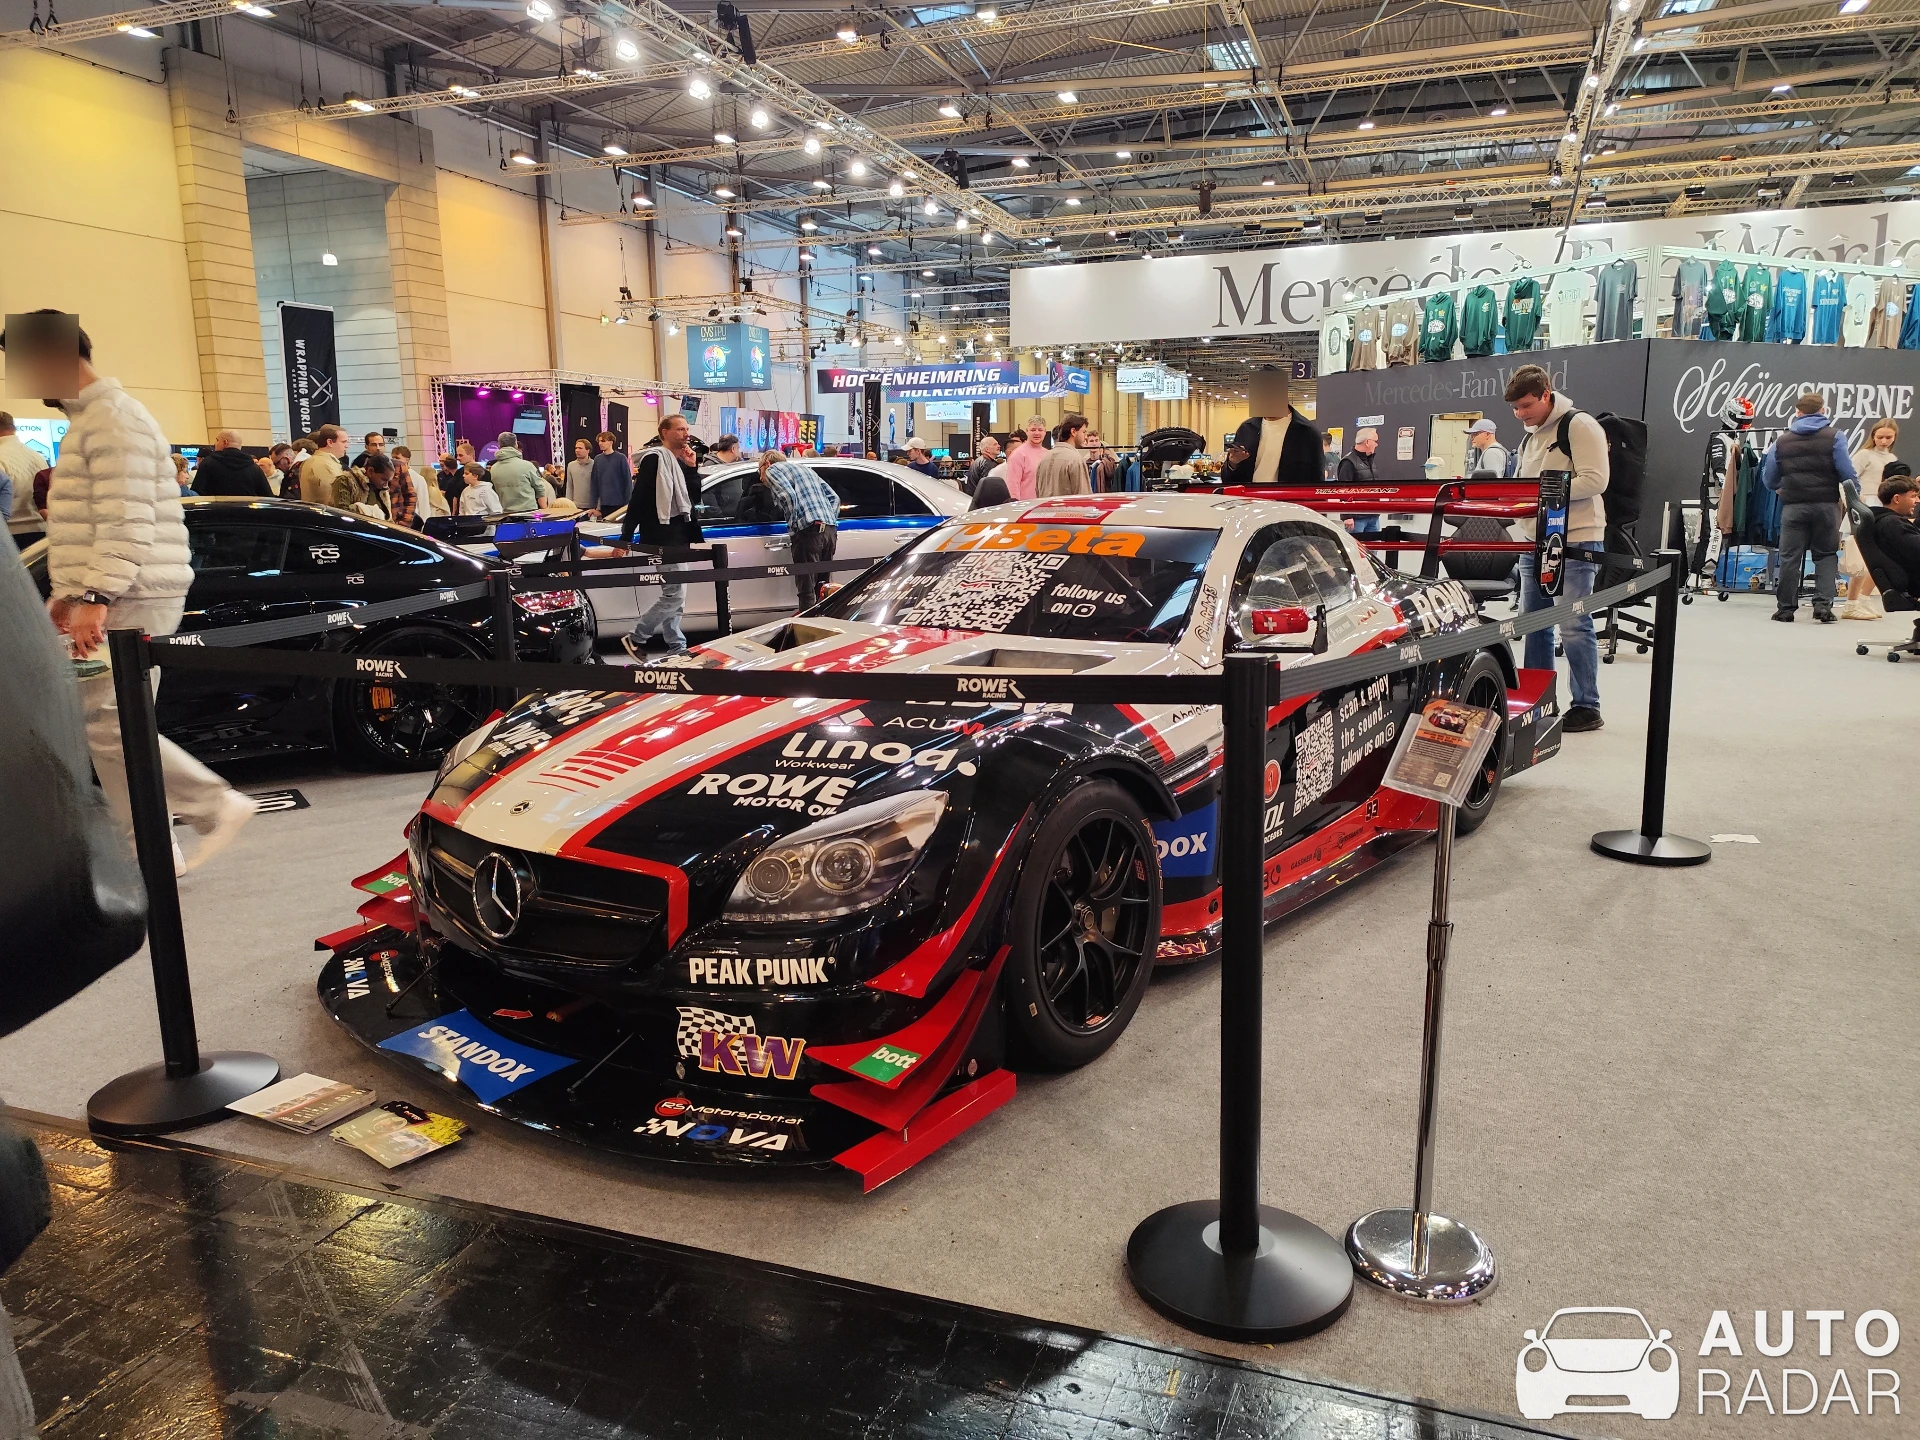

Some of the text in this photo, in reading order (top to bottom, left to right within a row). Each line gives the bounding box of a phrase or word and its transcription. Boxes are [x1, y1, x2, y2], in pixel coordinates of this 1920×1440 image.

[1296, 362, 1306, 379] 3
[1364, 359, 1569, 407] Mercedes-FanWld
[295, 339, 312, 434] WRAPPING WORLD
[978, 523, 1147, 558] Beta
[640, 574, 660, 582] ROWE
[439, 590, 455, 601] ROWE
[1050, 583, 1128, 606] follow us
[327, 612, 348, 624] ROWE
[1050, 602, 1072, 615] on
[355, 658, 395, 673] ROWE
[1400, 645, 1419, 661] ROWE
[634, 670, 679, 685] ROWE
[957, 678, 1009, 693] ROWE
[1339, 701, 1360, 724] scan
[1367, 674, 1389, 702] enjoy
[1340, 701, 1394, 750] the sound...
[1521, 702, 1553, 728] NOVA
[774, 759, 856, 771] Workwear
[1339, 730, 1385, 776] follow us on
[687, 773, 857, 805] ROWE
[733, 796, 839, 817] MOTOR OIL
[342, 956, 371, 1000] NOVA
[688, 956, 830, 986] PEAK PUNK
[417, 1024, 536, 1083] STANDOX
[698, 1030, 807, 1081] KW
[871, 1045, 917, 1070] bott
[633, 1117, 790, 1152] NOVA
